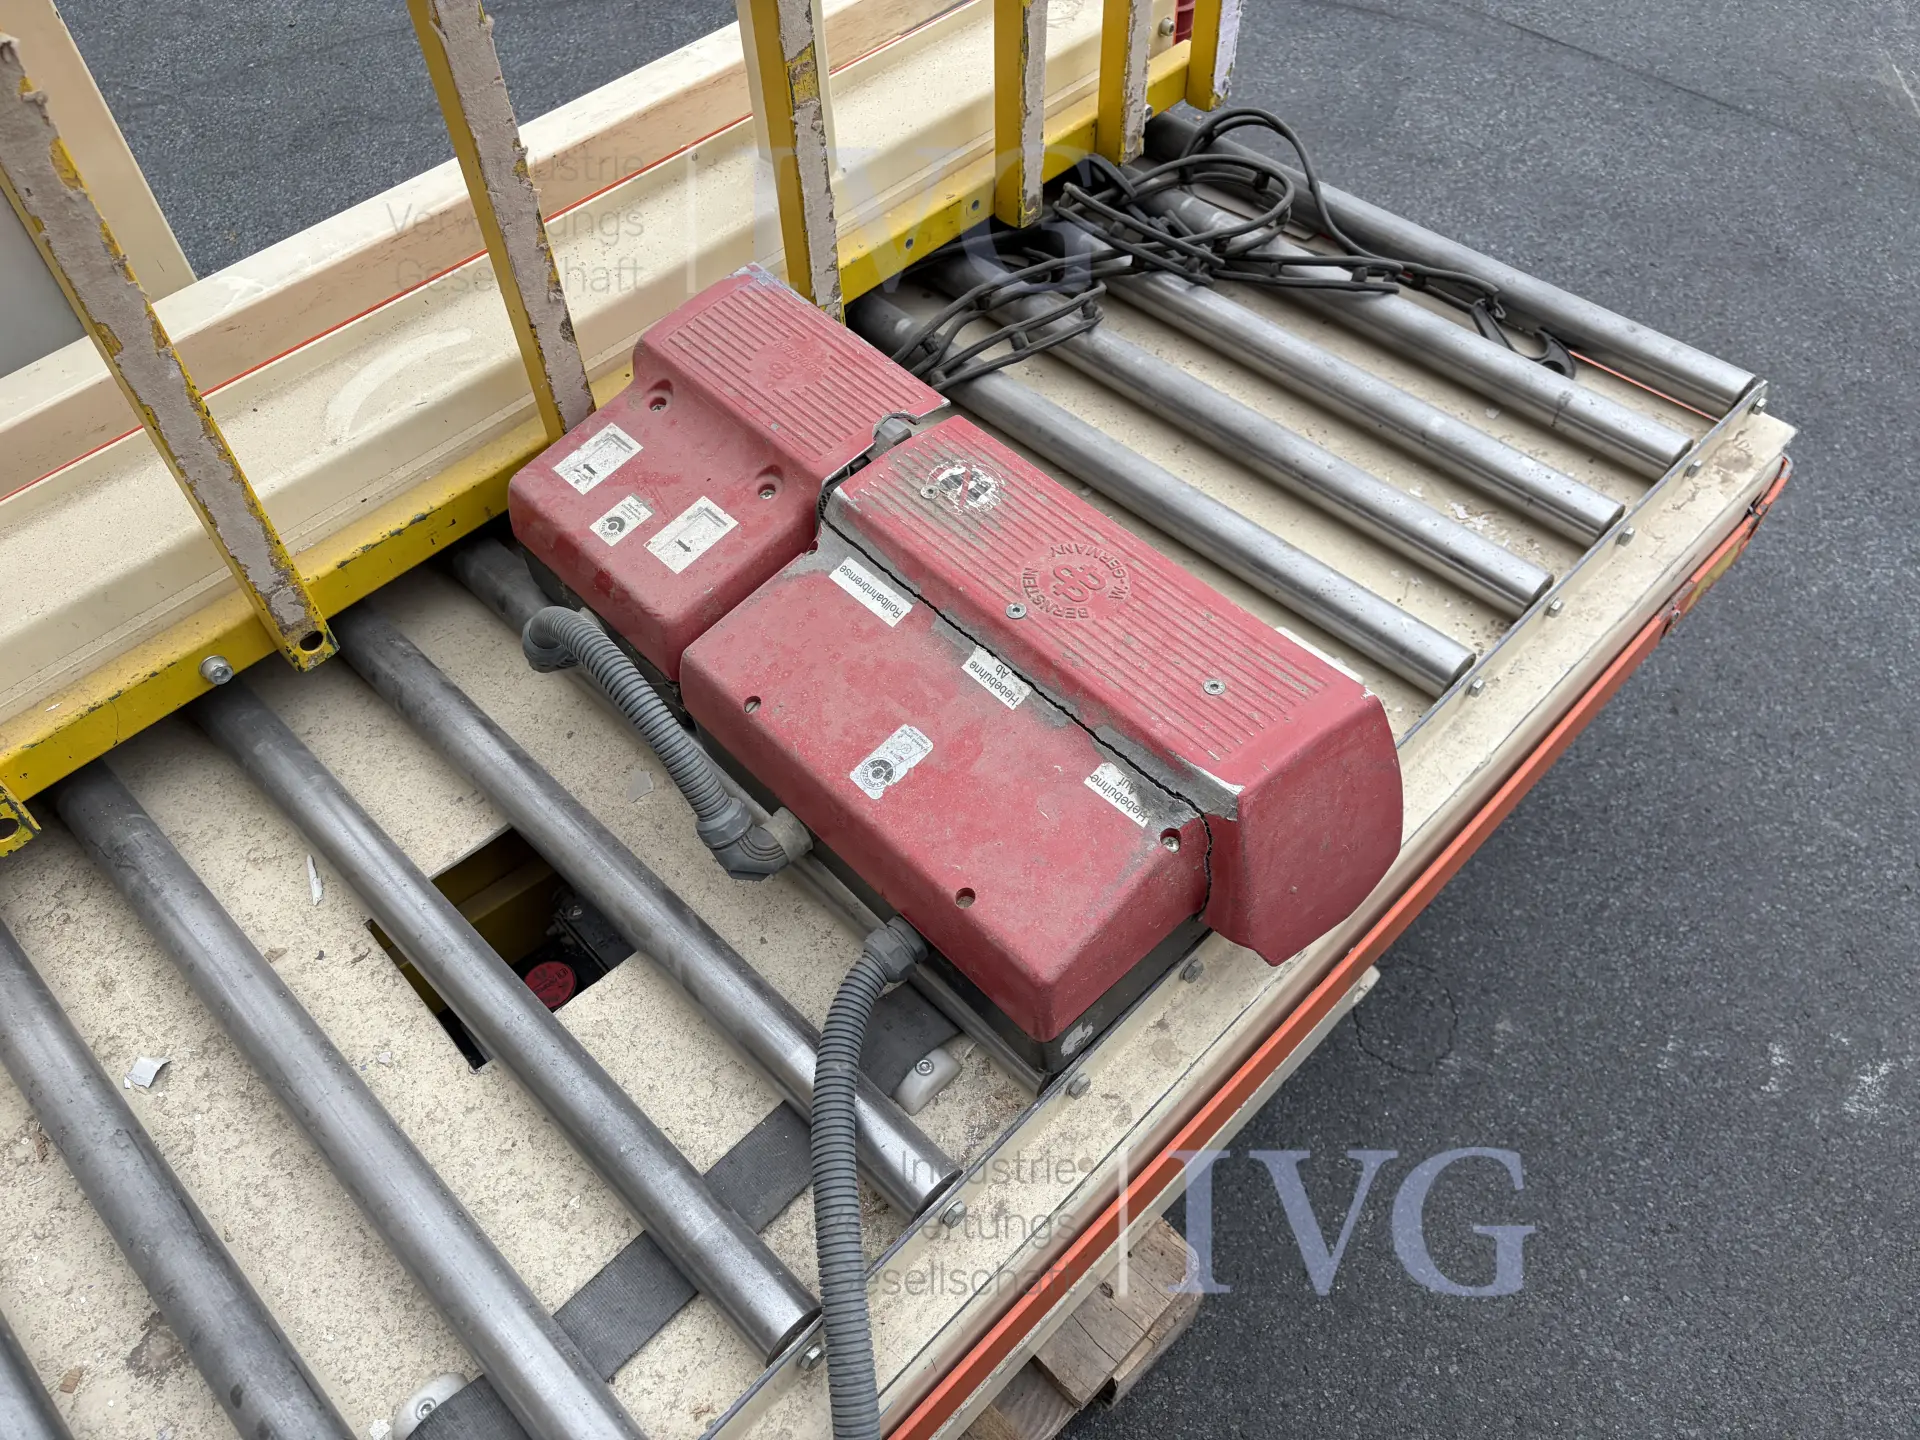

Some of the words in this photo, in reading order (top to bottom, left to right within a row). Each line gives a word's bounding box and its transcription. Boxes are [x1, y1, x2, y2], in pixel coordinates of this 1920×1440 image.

[839, 564, 904, 619] Rollbahnbremse
[1022, 567, 1090, 619] BERNSTEIN
[968, 659, 1020, 707] Hebebühne
[995, 663, 1011, 679] Ab
[1090, 773, 1148, 823] Hebebühne
[1118, 776, 1136, 796] Auf
